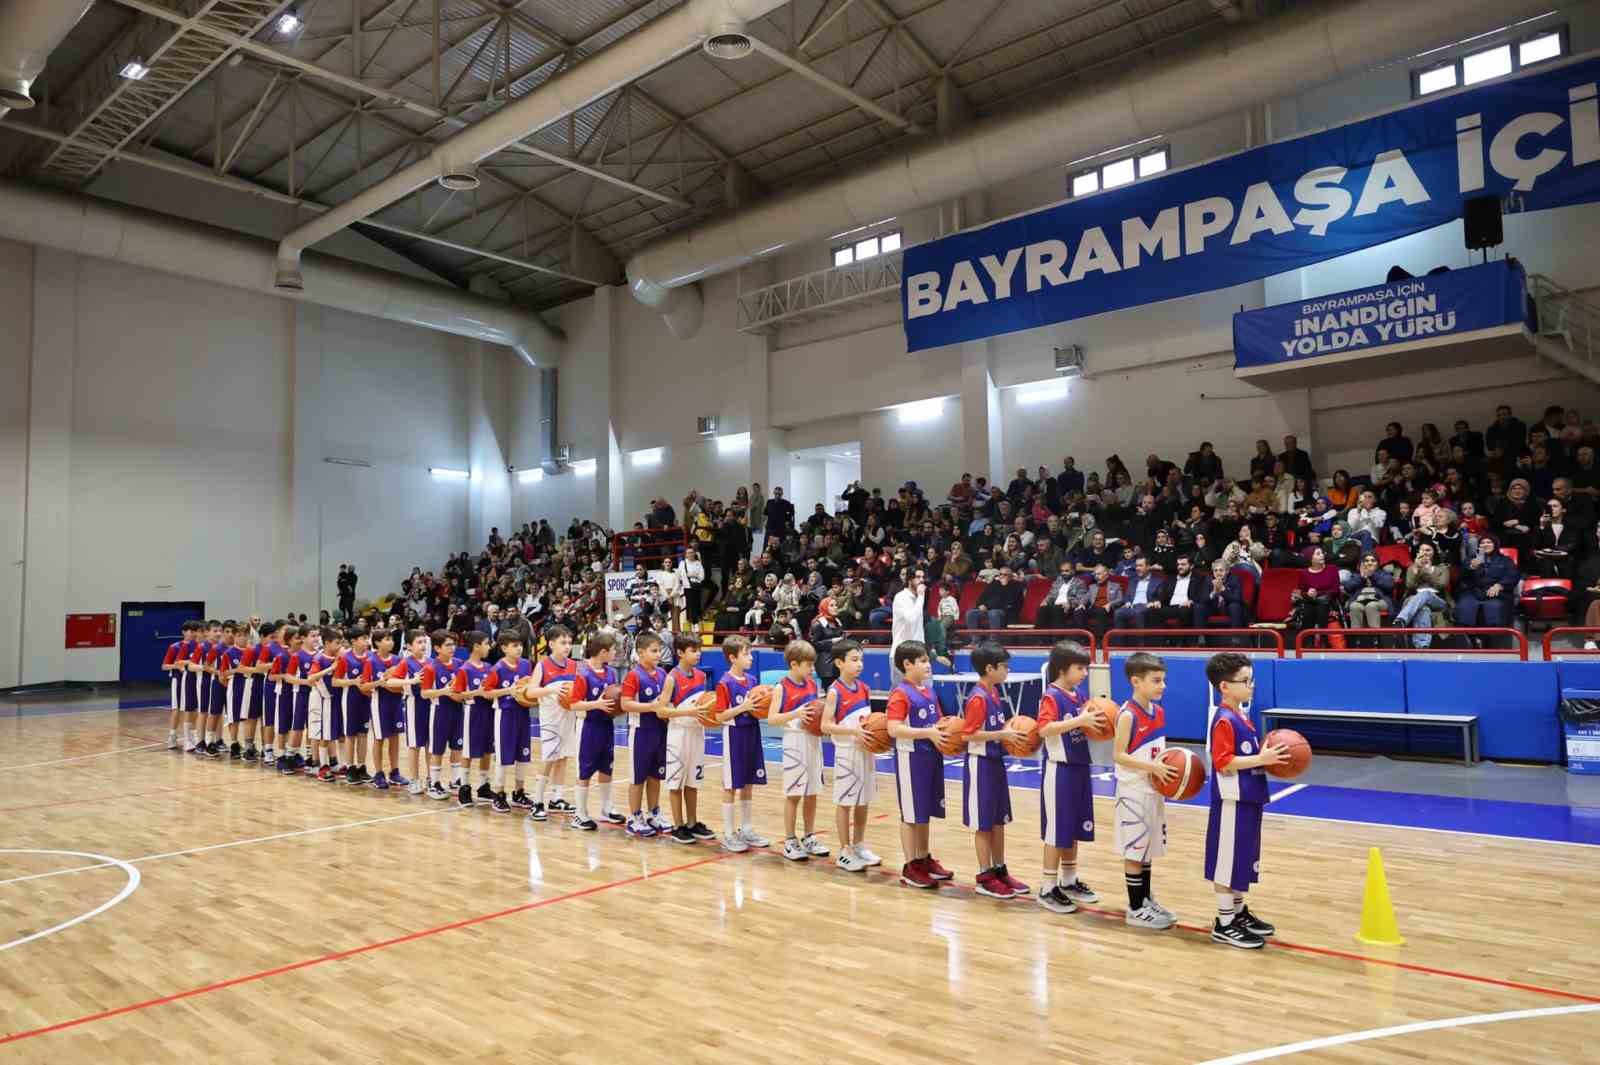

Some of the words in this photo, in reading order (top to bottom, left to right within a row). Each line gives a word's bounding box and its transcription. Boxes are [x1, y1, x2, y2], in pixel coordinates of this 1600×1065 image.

[907, 148, 1431, 319] BAYRAMPAŞA
[1456, 82, 1600, 192] İÇİ
[1302, 289, 1394, 315] BAYRAMPAŞA
[1281, 328, 1369, 357] YOLDA
[1376, 311, 1456, 341] YÜRÜ
